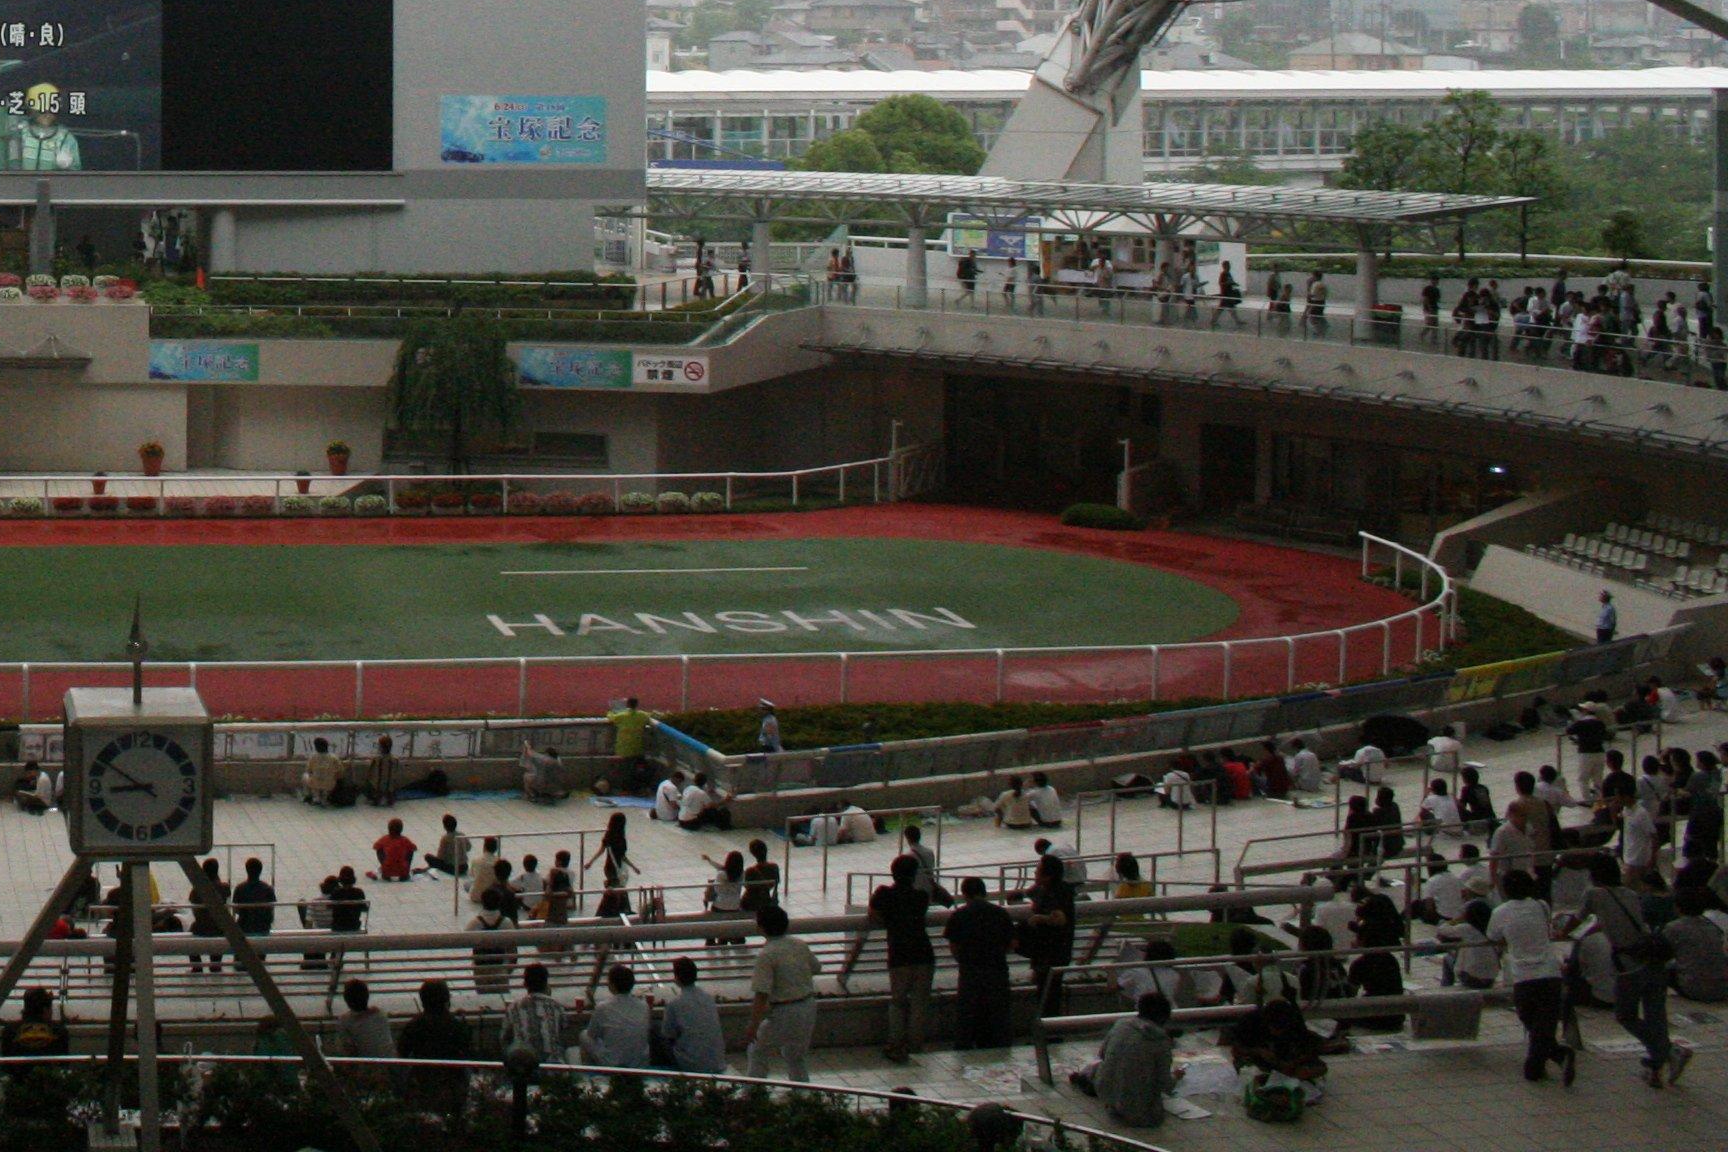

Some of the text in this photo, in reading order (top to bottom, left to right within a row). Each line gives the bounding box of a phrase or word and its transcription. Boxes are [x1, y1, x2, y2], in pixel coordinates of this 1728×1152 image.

[487, 115, 602, 142] 宝塚記念
[485, 607, 977, 637] HANSHIN
